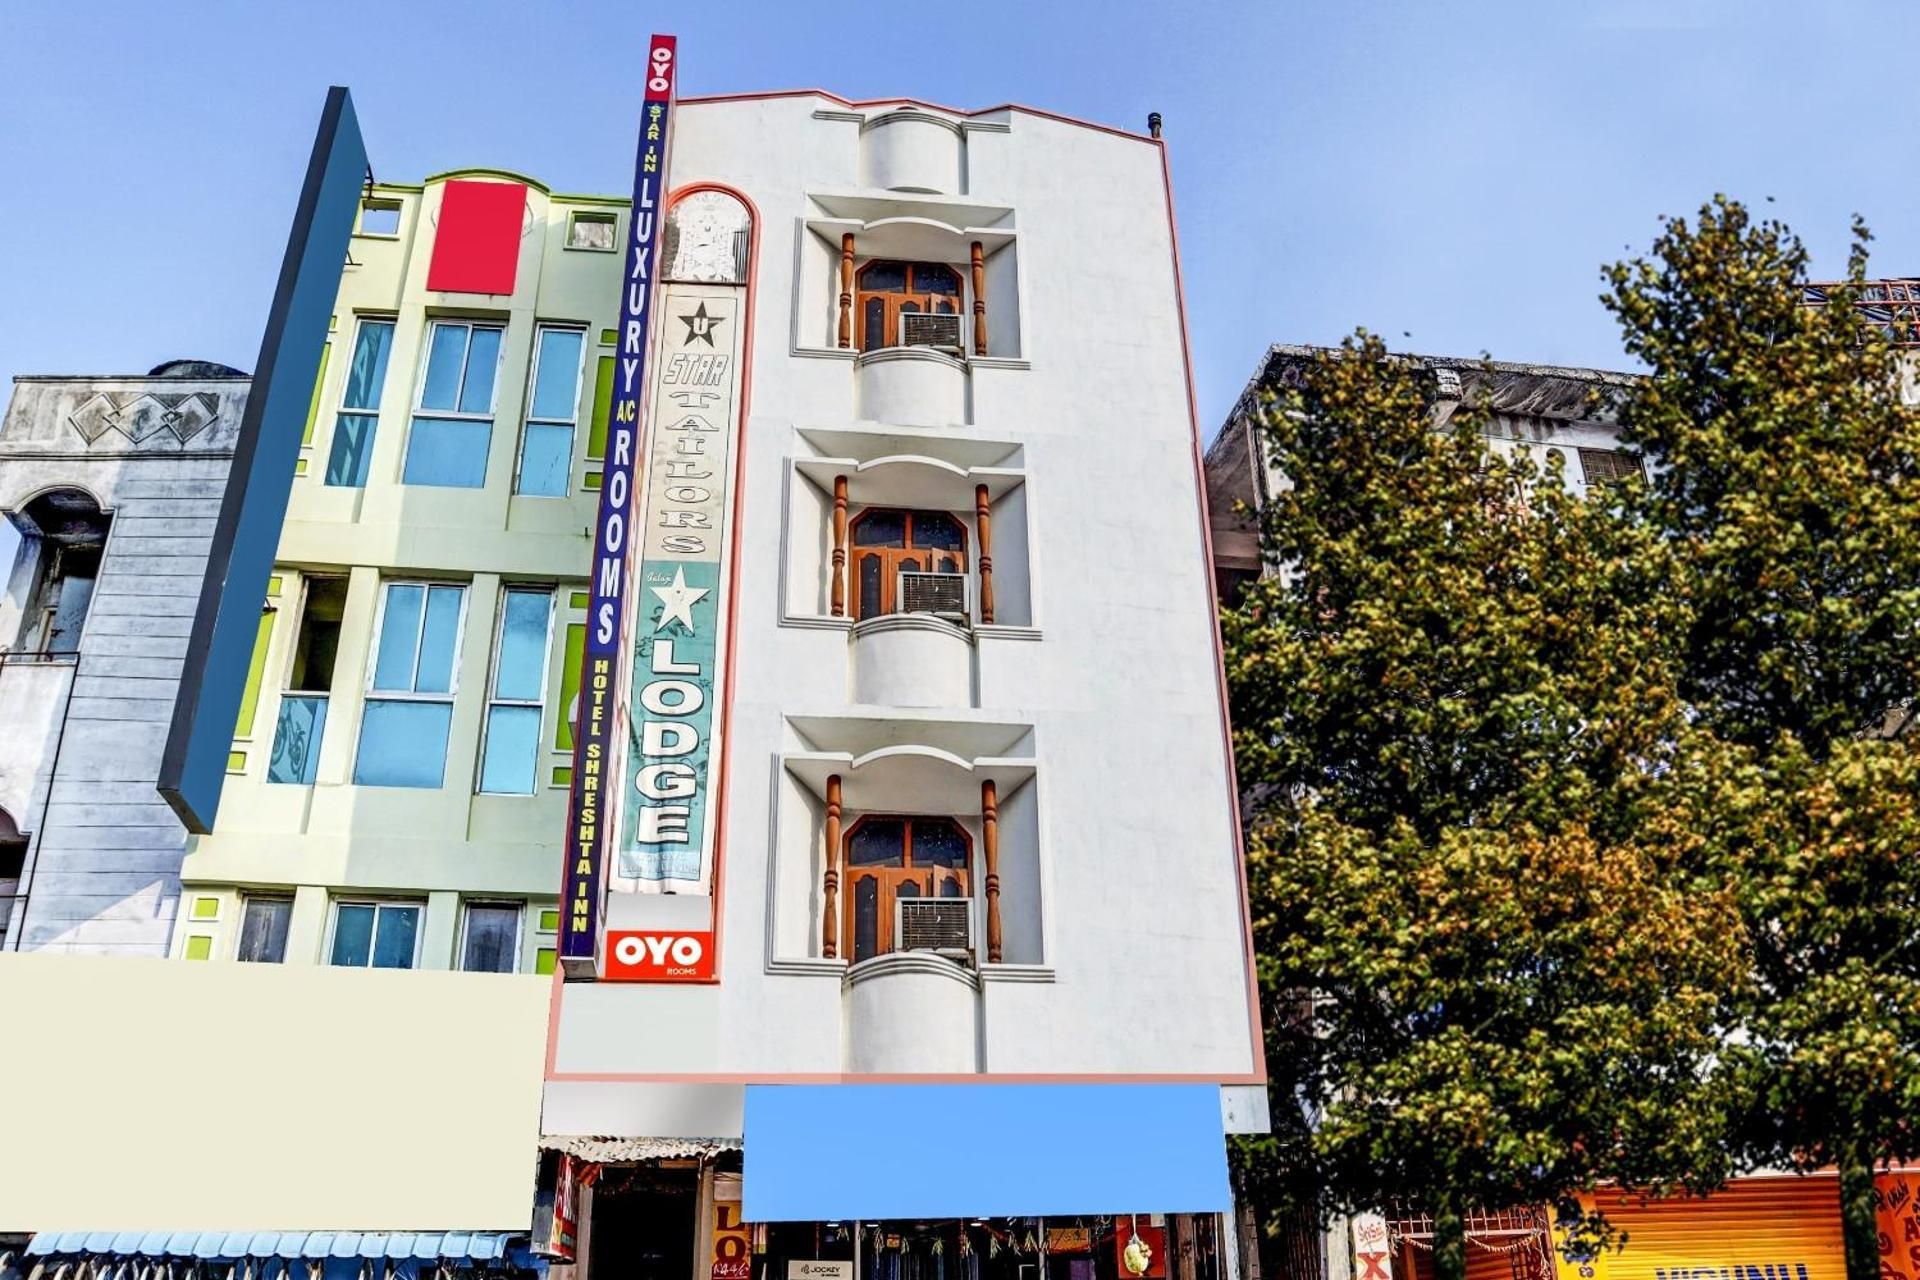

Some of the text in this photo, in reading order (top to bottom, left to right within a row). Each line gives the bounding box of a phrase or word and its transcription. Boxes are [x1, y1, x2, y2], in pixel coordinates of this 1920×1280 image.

[648, 47, 672, 92] OYO
[643, 105, 662, 172] STAR INN
[663, 353, 728, 386] STAR
[597, 178, 653, 645] LUXURY A/C ROOMS
[659, 391, 721, 554] TAILORS
[635, 638, 705, 845] LODGE
[571, 660, 609, 933] HOTEL SHRESHTA INN
[615, 936, 702, 966] OYO
[666, 967, 697, 976] ROOMS
